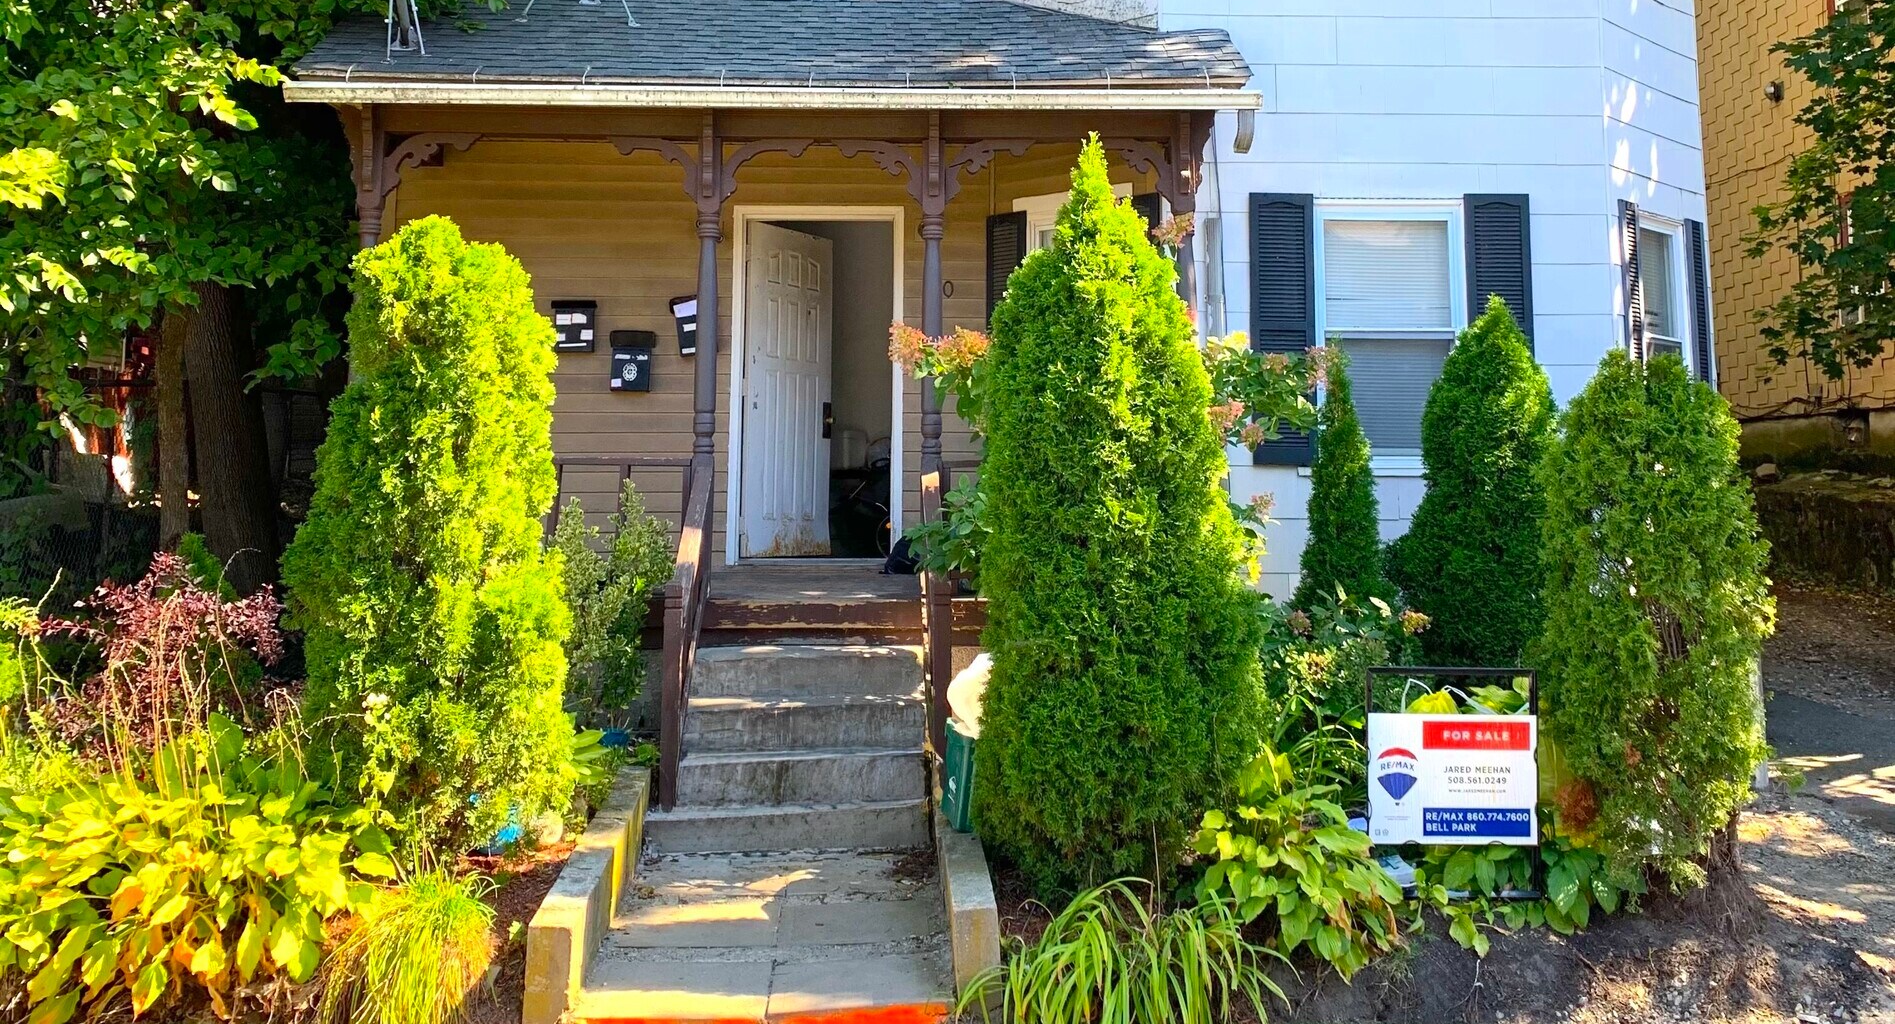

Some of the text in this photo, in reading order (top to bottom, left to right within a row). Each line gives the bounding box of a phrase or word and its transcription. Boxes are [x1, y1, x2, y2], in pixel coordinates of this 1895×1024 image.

[1443, 730, 1511, 741] FOR SALE
[1380, 761, 1415, 771] RE/MAX
[1443, 766, 1511, 774] JARED MEEHAN
[1448, 776, 1507, 784] 508.561.0249
[1425, 811, 1529, 822] RE/MAX 860.774.7600
[1425, 823, 1477, 832] BELL PARK
